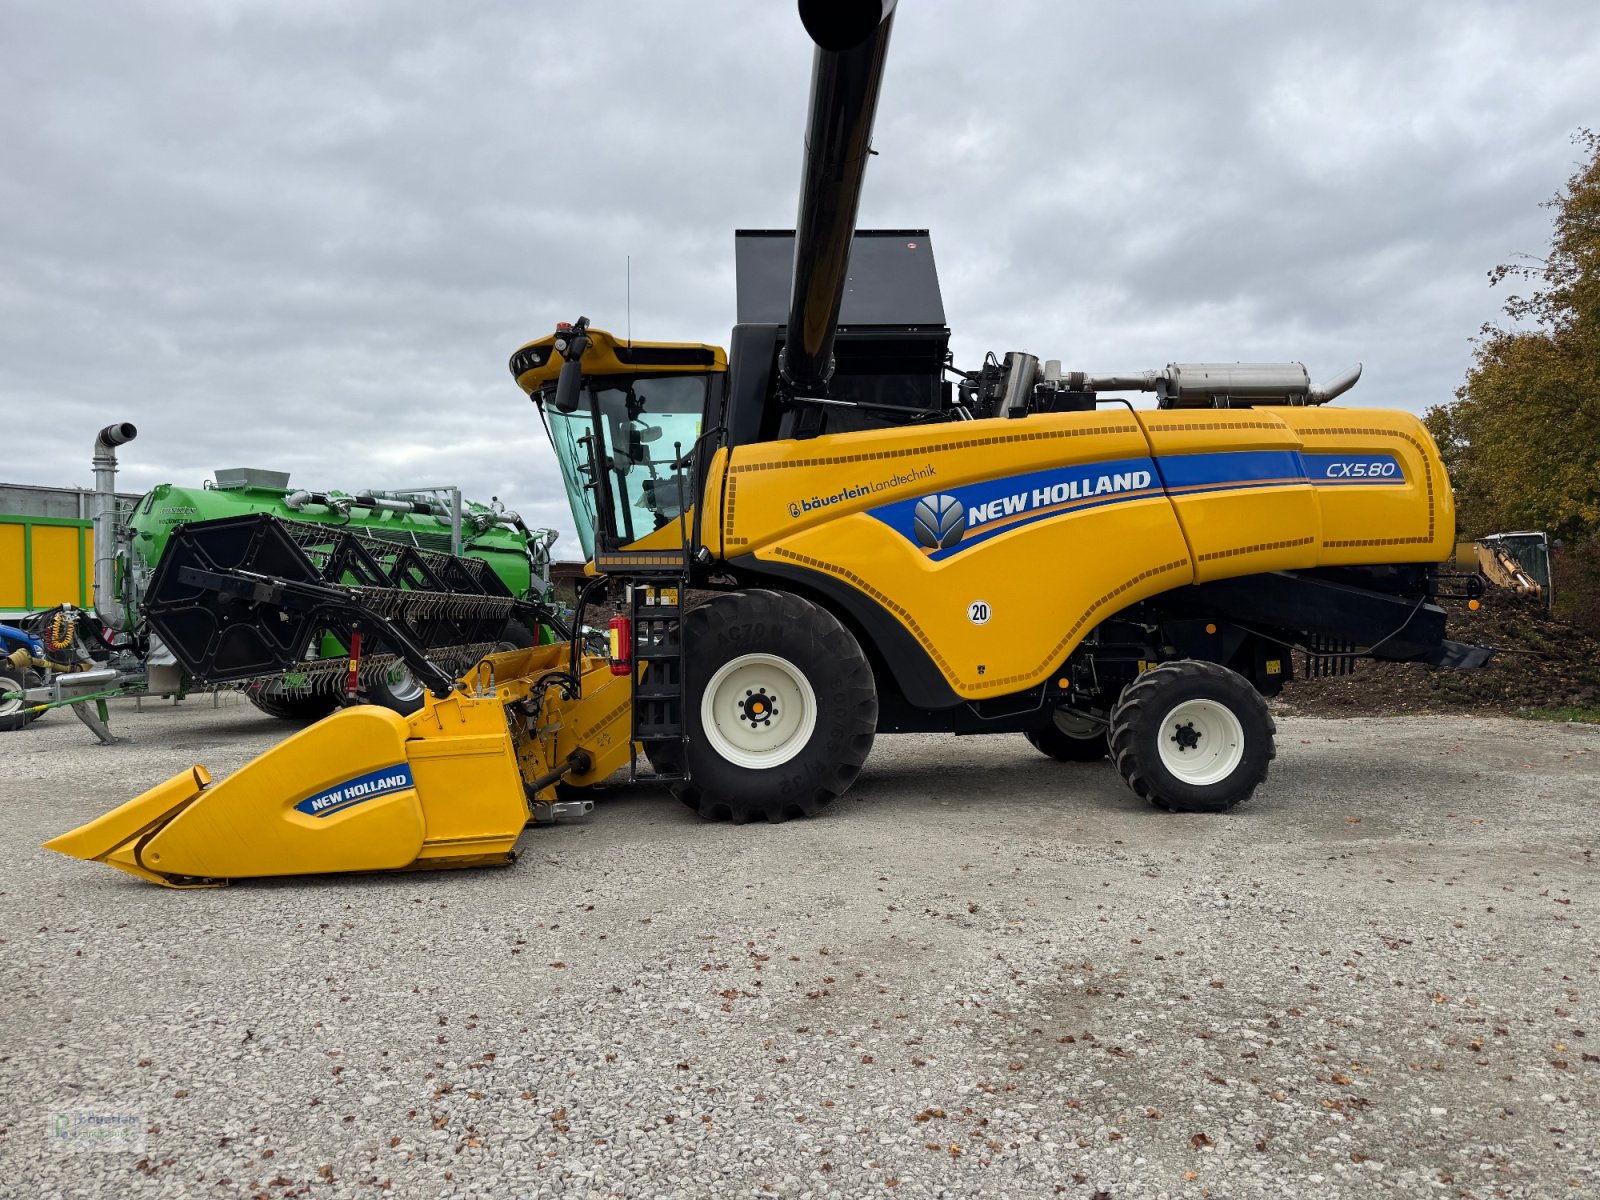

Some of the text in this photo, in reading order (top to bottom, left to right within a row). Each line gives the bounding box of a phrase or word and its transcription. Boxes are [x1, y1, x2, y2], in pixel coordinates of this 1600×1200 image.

[801, 463, 937, 512] bäuerlein Landtechnik
[1326, 462, 1395, 478] CX5.80
[968, 470, 1151, 526] NEW HOLLAND
[972, 604, 987, 620] 20
[311, 774, 407, 811] NEW HOLLAND
